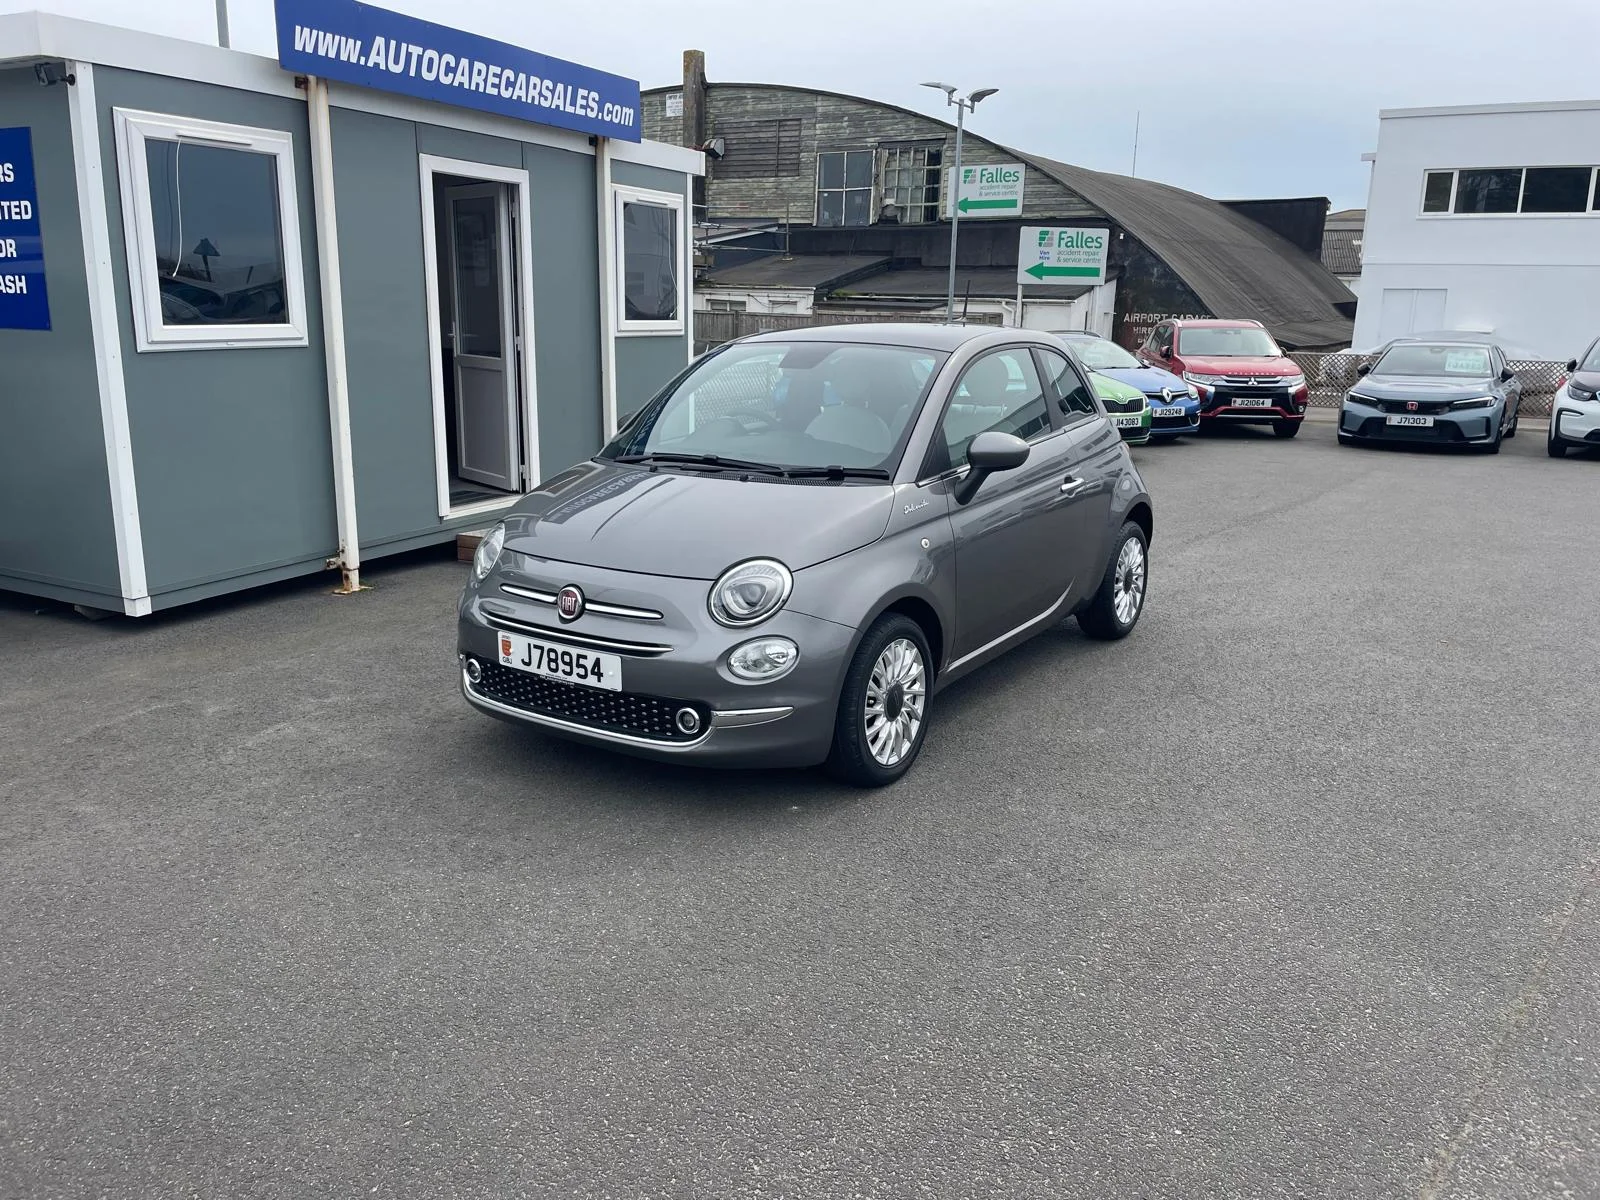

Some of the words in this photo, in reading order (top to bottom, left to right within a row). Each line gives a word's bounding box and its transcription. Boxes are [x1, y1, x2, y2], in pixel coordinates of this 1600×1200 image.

[294, 25, 634, 127] www.AUTOCARECARSALES.com
[0, 162, 15, 183] S
[979, 168, 1020, 184] Falles
[0, 200, 32, 220] TED
[1057, 230, 1103, 249] Falles
[1123, 313, 1168, 323] AIRPORT
[1159, 408, 1182, 416] J129248
[1116, 417, 1139, 427] J143083
[1397, 416, 1427, 425] J71303
[562, 596, 576, 612] FIAT
[520, 642, 604, 683] J78954
